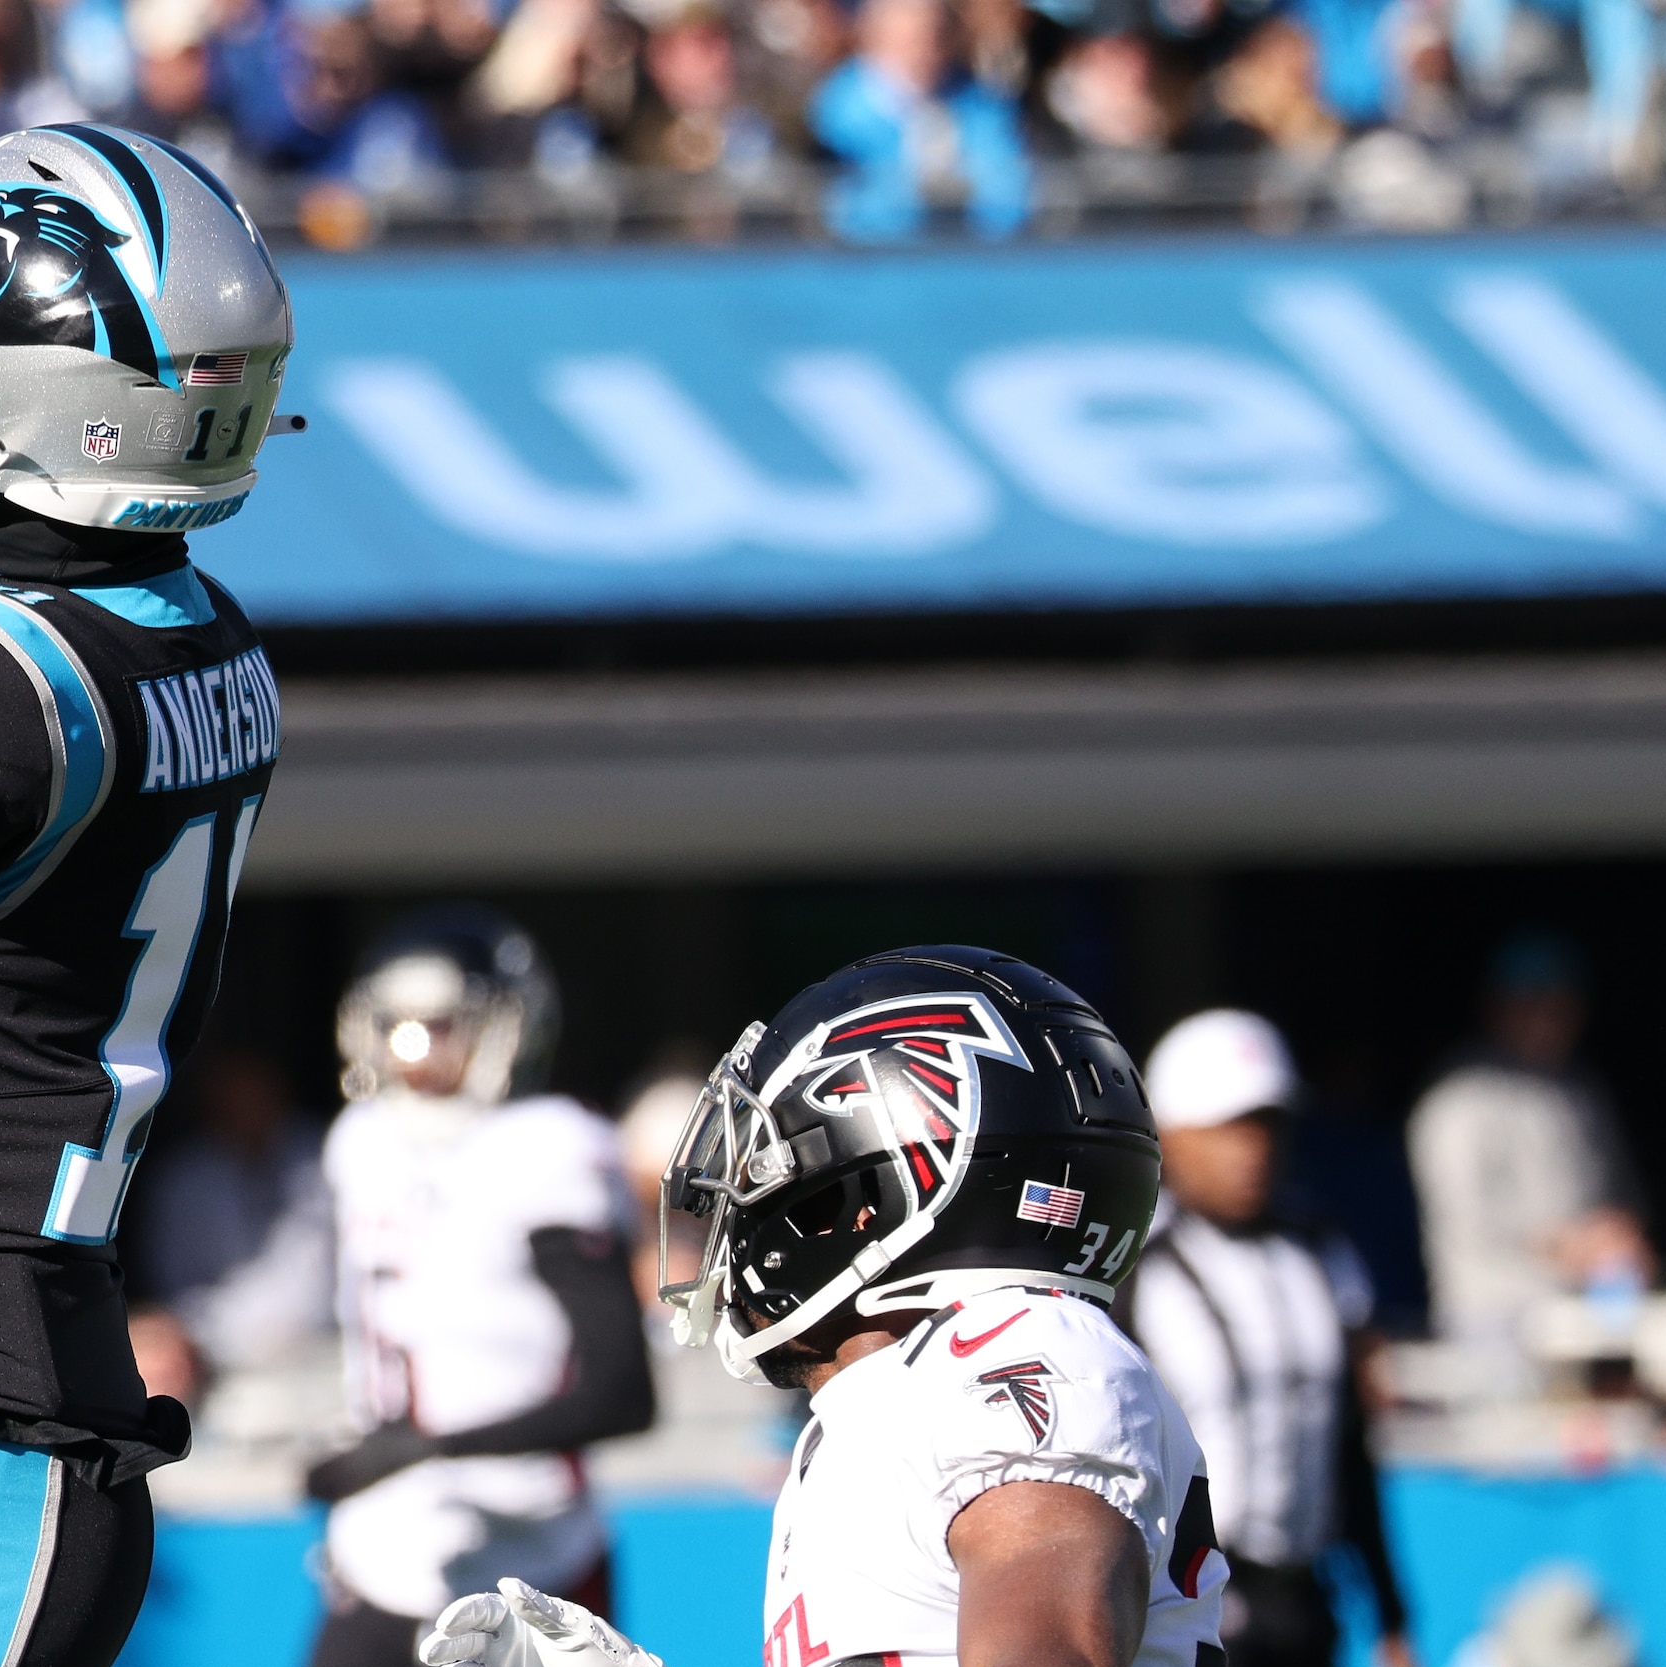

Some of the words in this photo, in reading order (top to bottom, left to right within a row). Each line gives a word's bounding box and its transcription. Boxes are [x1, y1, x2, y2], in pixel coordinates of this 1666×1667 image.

[87, 436, 114, 456] NFL
[182, 404, 253, 462] 11
[1063, 1222, 1136, 1279] 34
